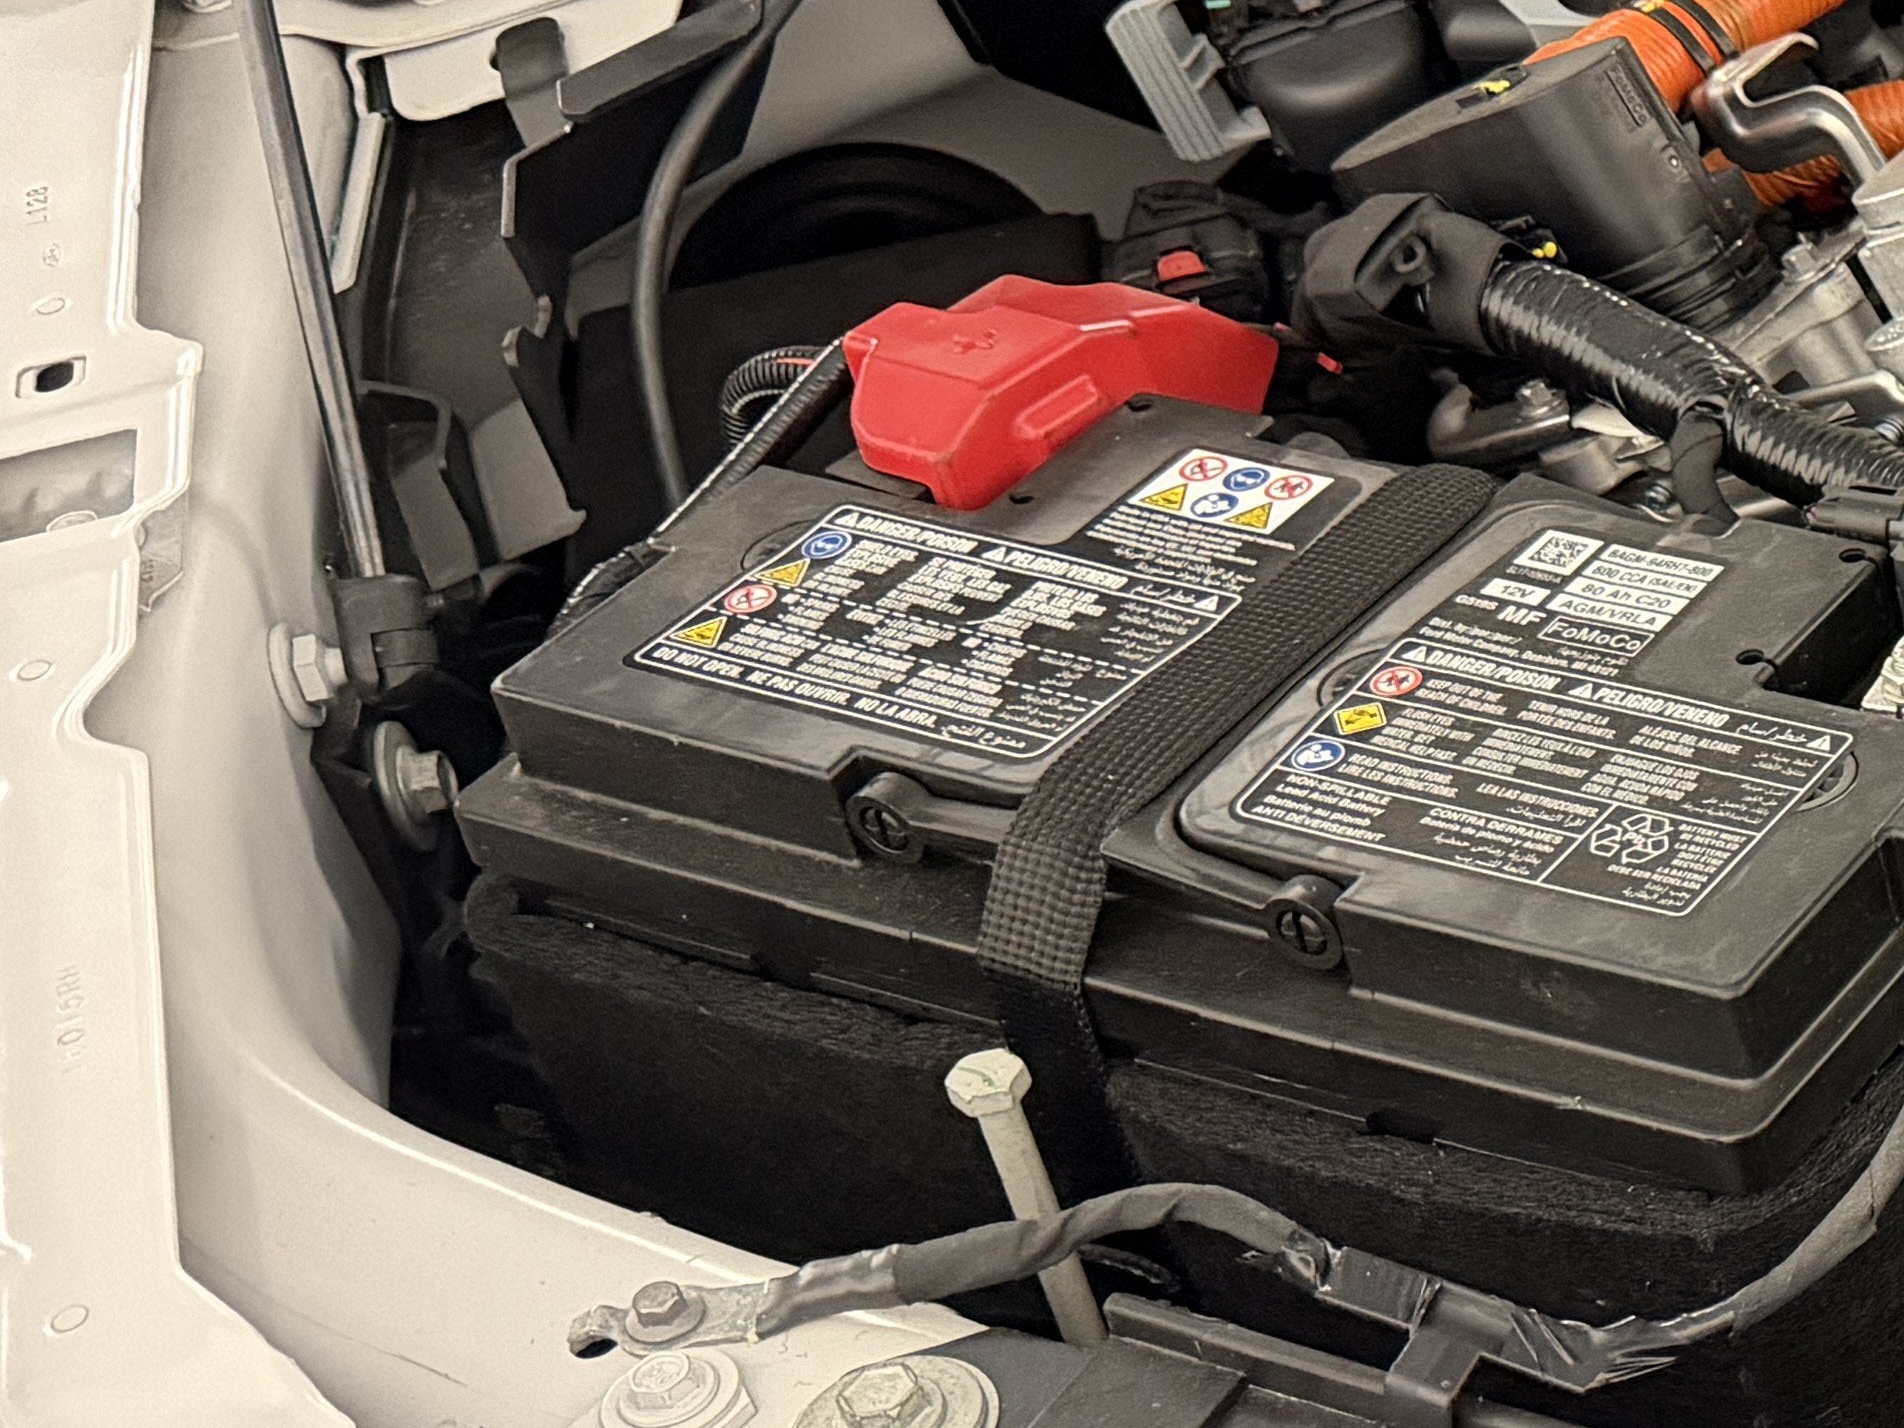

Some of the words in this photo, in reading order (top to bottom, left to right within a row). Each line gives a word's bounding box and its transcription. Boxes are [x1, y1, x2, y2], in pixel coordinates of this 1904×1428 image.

[850, 515, 982, 554] DANGER/POISON
[1496, 584, 1536, 599] 12V
[1615, 570, 1651, 585] CCA
[1604, 588, 1636, 601] Ah
[1631, 594, 1674, 609] C20
[1493, 605, 1549, 628] MF
[1556, 599, 1660, 627] AGM/VRLA
[1544, 620, 1647, 652] FoMoCo
[648, 646, 682, 661] DO
[671, 652, 709, 667] NOT
[763, 675, 802, 691] PAS
[849, 696, 883, 711] NO
[872, 702, 902, 716] LA
[1421, 649, 1564, 691] DANGER/POISON
[1589, 685, 1734, 728] PELIGRO/VENENO
[1283, 774, 1394, 806] NON-SPILLABLE
[1306, 791, 1339, 804] Acid
[1334, 798, 1387, 817] Battery
[1311, 807, 1332, 817] au
[1426, 806, 1489, 827] CONTRA
[1484, 820, 1565, 845] DERRAMES
